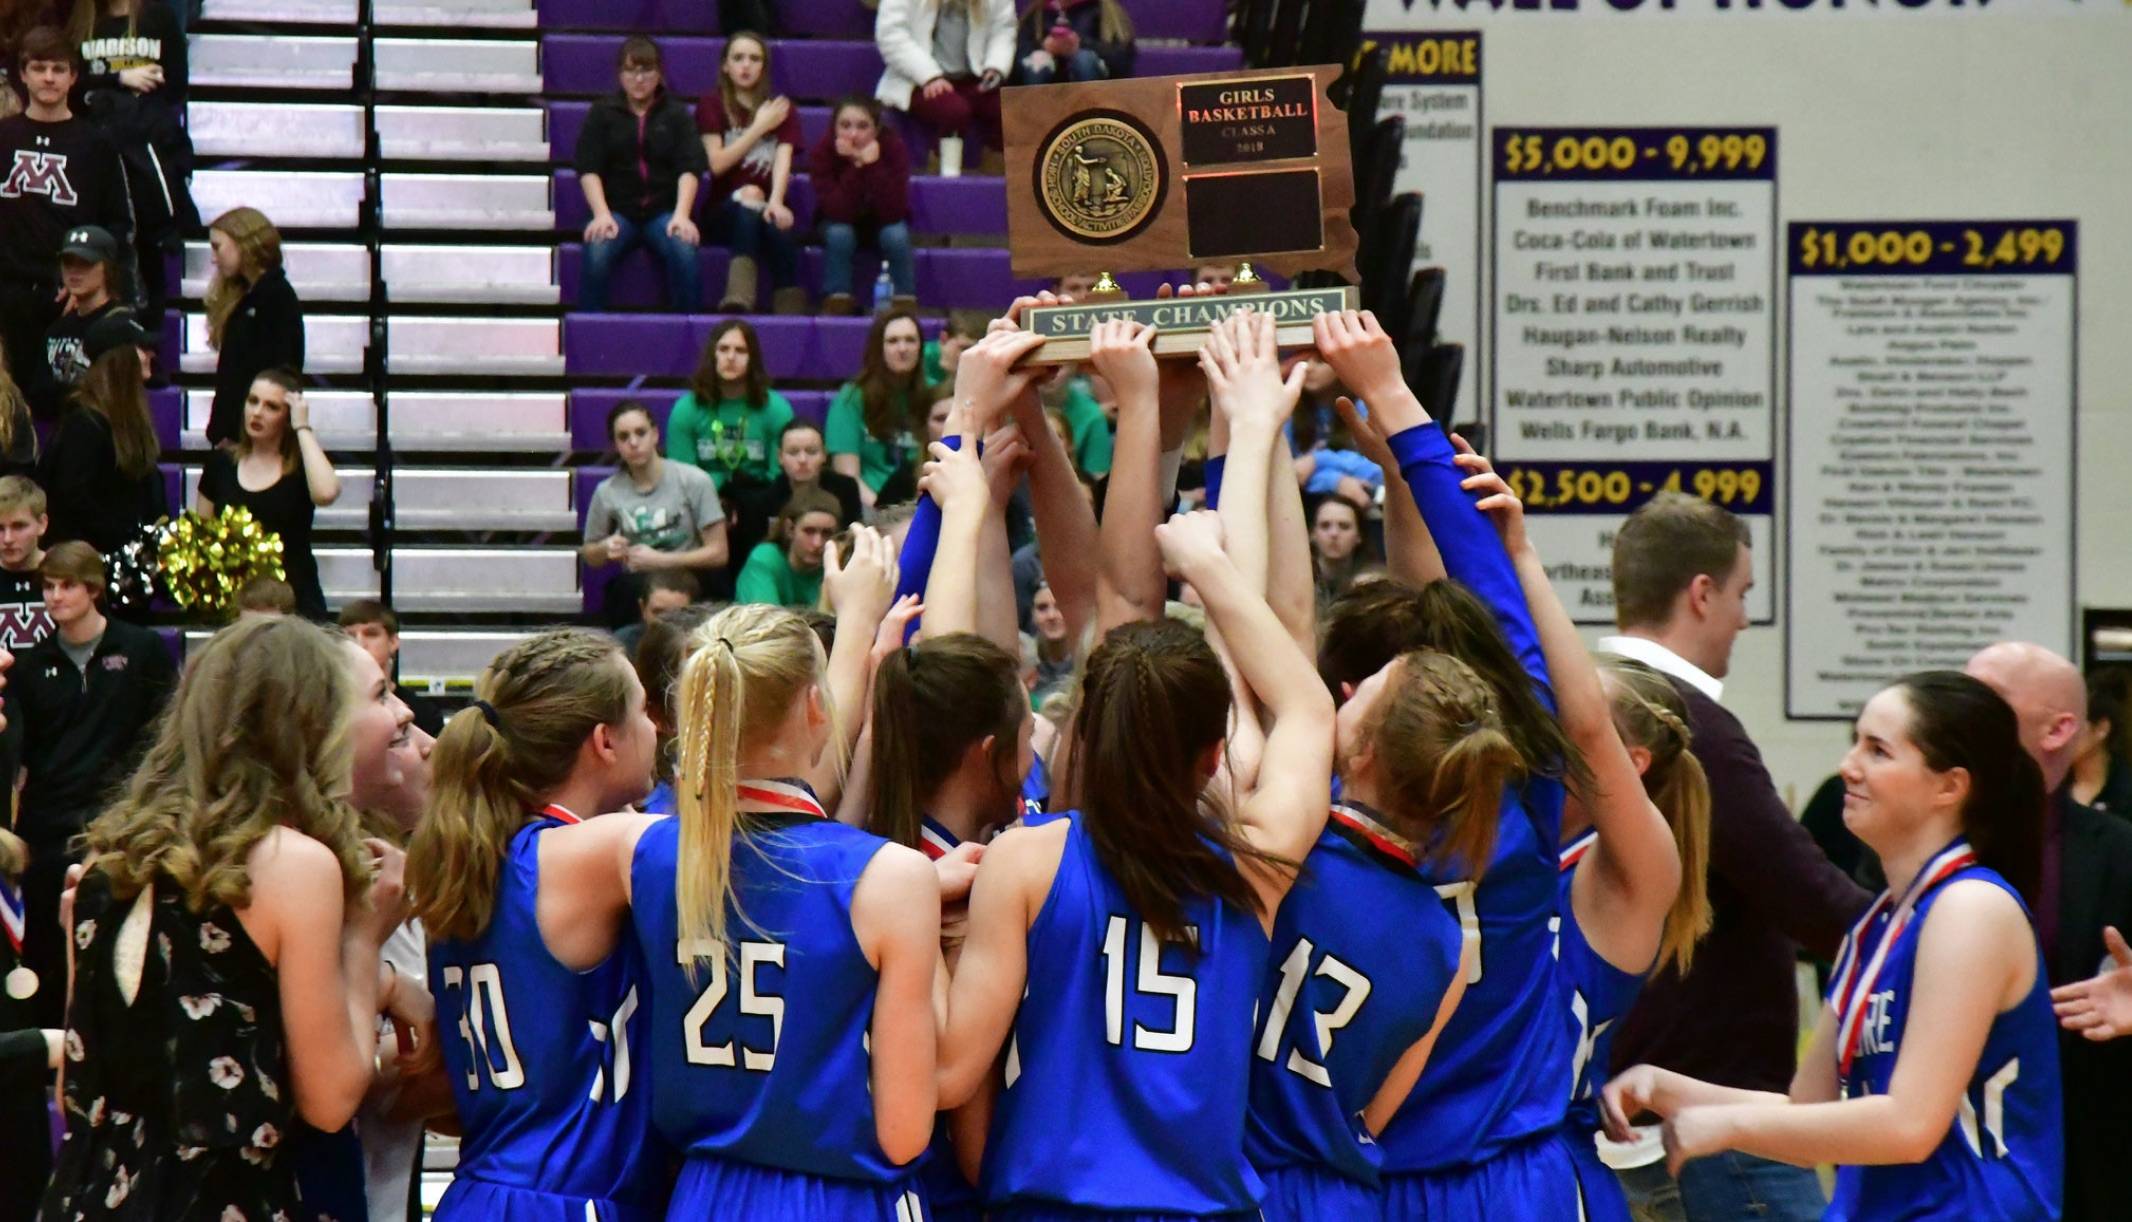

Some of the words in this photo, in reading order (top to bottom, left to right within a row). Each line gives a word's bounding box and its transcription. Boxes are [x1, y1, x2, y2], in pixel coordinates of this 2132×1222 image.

[1387, 39, 1477, 75] MORE
[1220, 89, 1275, 104] GIRLS
[1188, 103, 1308, 123] BASKETBALL
[1093, 124, 1138, 145] DAKOTA
[1222, 125, 1265, 138] CLASS
[1266, 125, 1276, 135] A
[1505, 133, 1637, 174] $5,000
[1666, 134, 1767, 174] 9,999
[0, 150, 78, 206] M
[1526, 198, 1638, 218] Benchmark
[1646, 198, 1700, 218] Foam
[1707, 198, 1743, 218] Inc.
[1513, 230, 1616, 249] Coca-Cola
[1622, 230, 1643, 249] of
[1649, 230, 1756, 249] Watertown
[1802, 227, 1932, 268] $1,000
[1963, 228, 2064, 268] 2,499
[1535, 261, 1580, 281] First
[1586, 261, 1635, 281] Bank
[1643, 261, 1679, 281] and
[1687, 261, 1735, 281] Trust
[1552, 293, 1578, 313] Ed
[1585, 293, 1621, 313] and
[1627, 293, 1683, 317] Cathy
[1682, 325, 1747, 348] Realty
[1546, 357, 1604, 379] Sharp
[1611, 357, 1724, 377] Automotive
[1506, 389, 1612, 409] Watertown
[1618, 389, 1681, 409] Public
[1687, 389, 1764, 411] Opinion
[1520, 421, 1575, 440] Wells
[1581, 421, 1638, 444] Fargo
[1706, 421, 1747, 440] N.A.
[1507, 468, 1632, 507] $2,500
[1103, 914, 1197, 1053] 15
[676, 938, 787, 1073] 25
[1257, 937, 1370, 1087] 13
